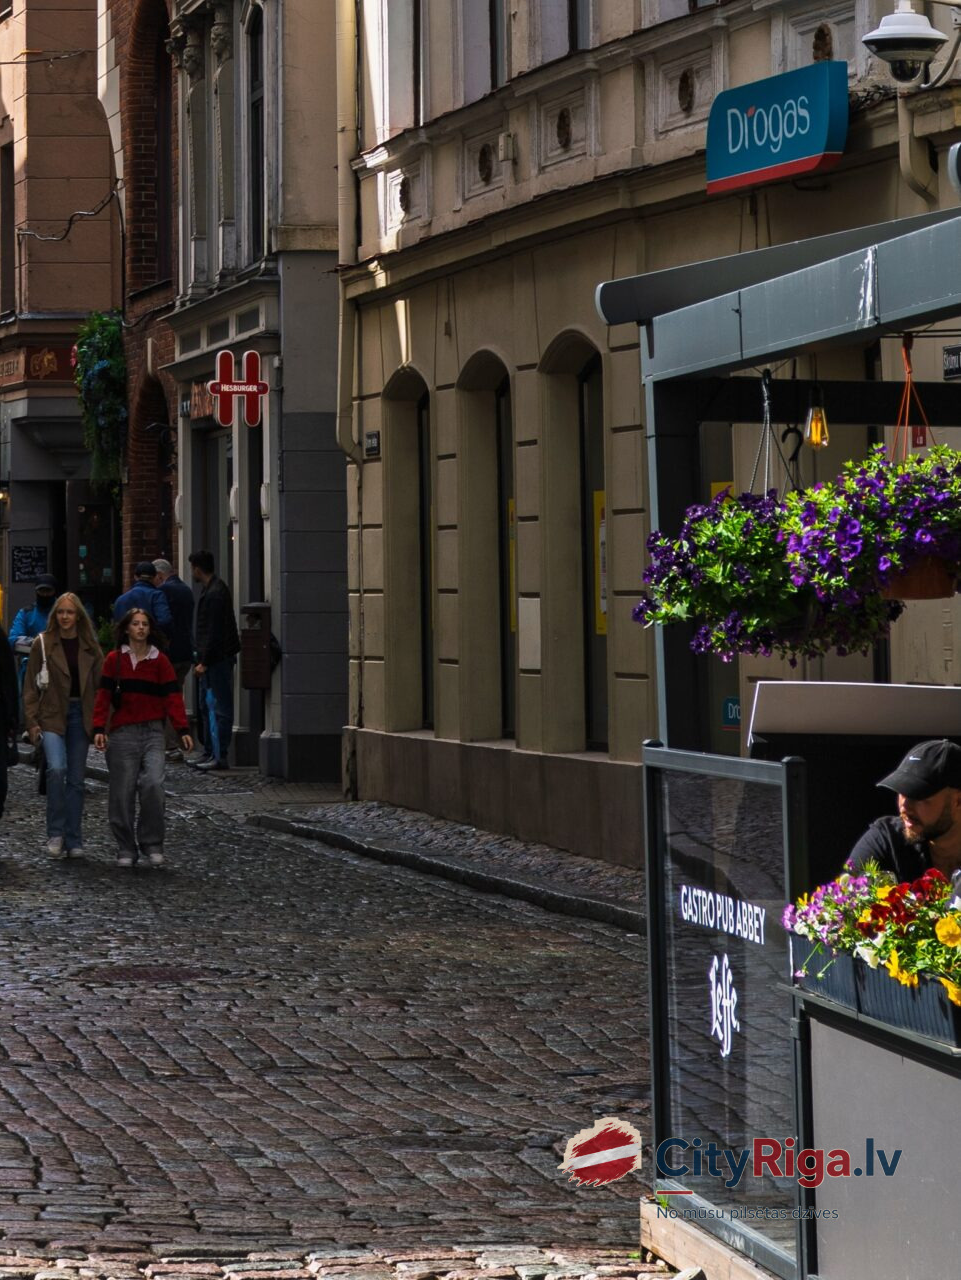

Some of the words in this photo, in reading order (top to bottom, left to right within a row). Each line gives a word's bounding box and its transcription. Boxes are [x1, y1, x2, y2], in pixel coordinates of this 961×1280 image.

[727, 96, 810, 154] Drogas
[220, 384, 258, 392] HESBURGER
[681, 885, 715, 928] GASTRO
[716, 893, 735, 934] PUB
[736, 900, 766, 945] ABBEY
